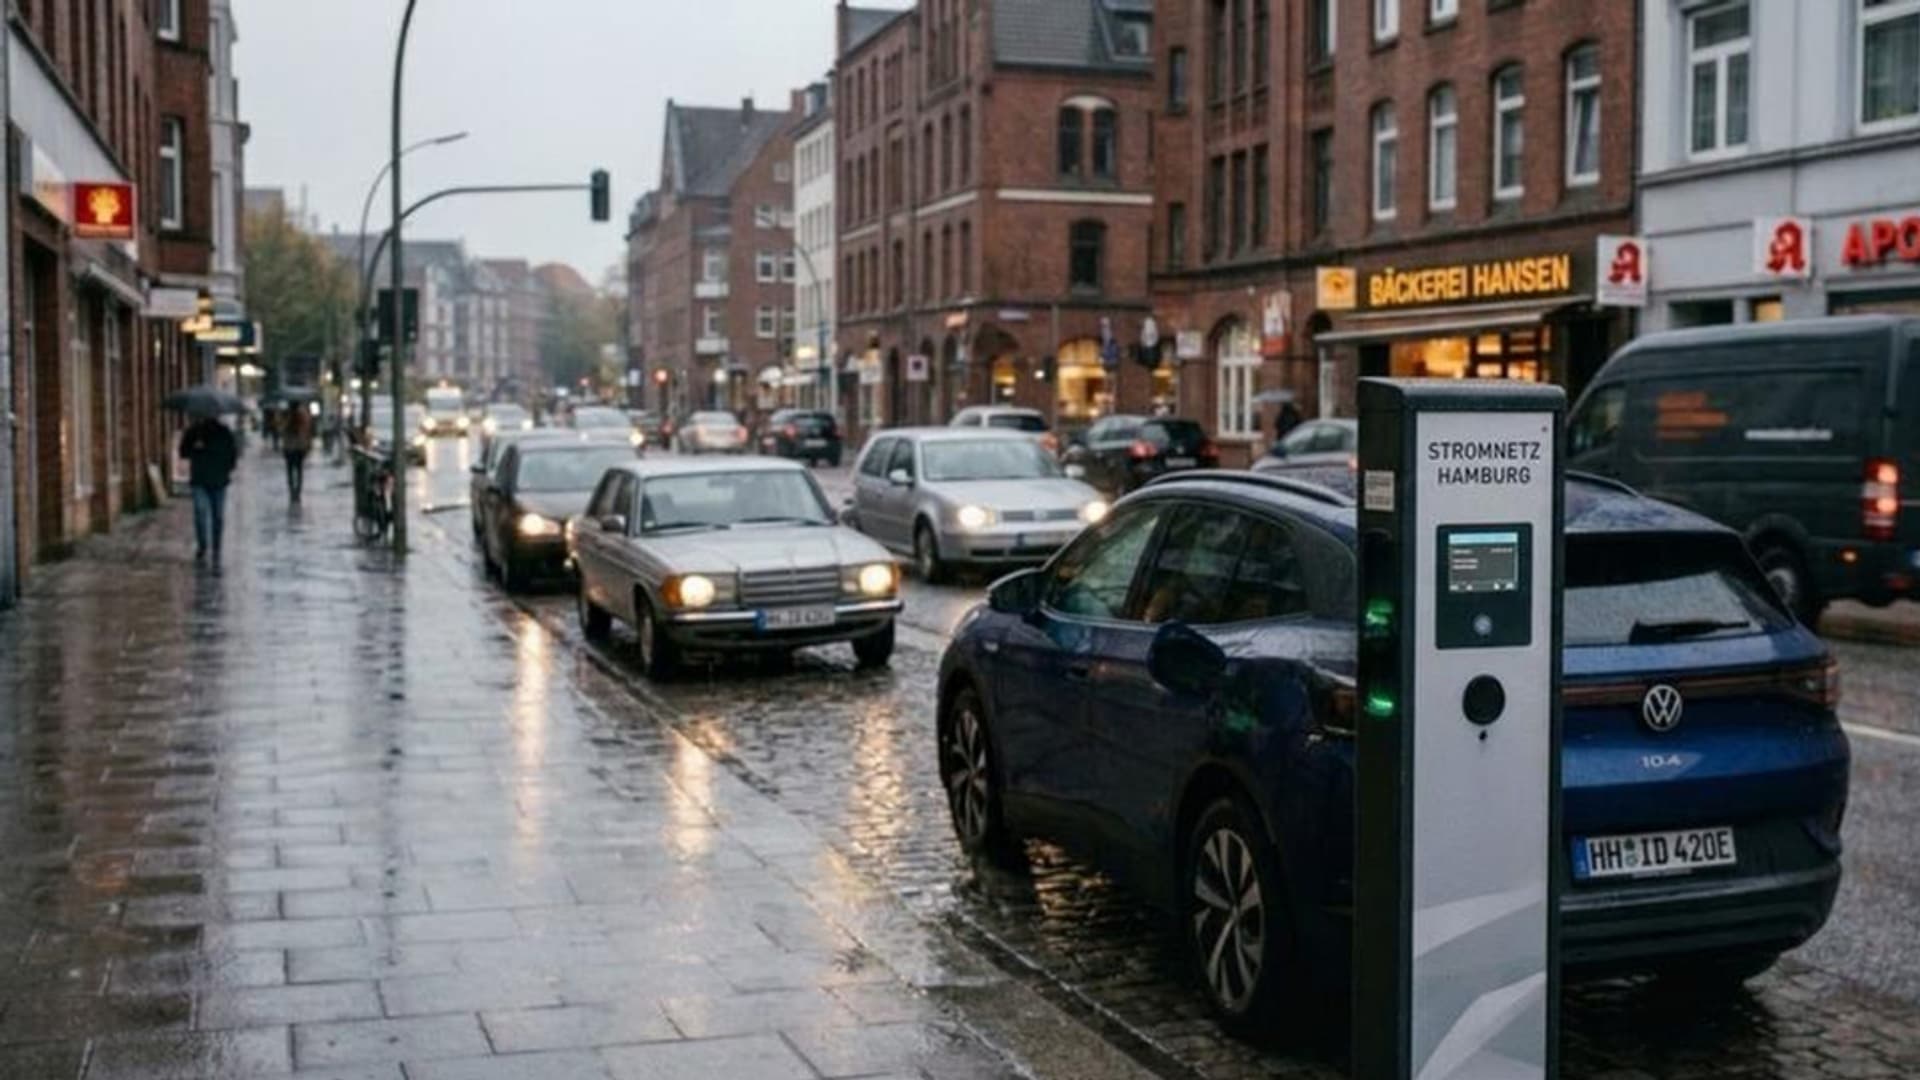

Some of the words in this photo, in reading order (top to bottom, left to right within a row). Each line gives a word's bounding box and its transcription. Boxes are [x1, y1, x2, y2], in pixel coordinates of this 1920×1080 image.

[1370, 267, 1467, 306] BÄCKEREI
[1473, 256, 1569, 295] HANSEN
[1428, 442, 1540, 460] STROMNETZ
[1438, 466, 1531, 484] HAMBURG
[1590, 839, 1622, 870] HH
[1641, 836, 1668, 866] ID
[1675, 830, 1730, 863] 420E
